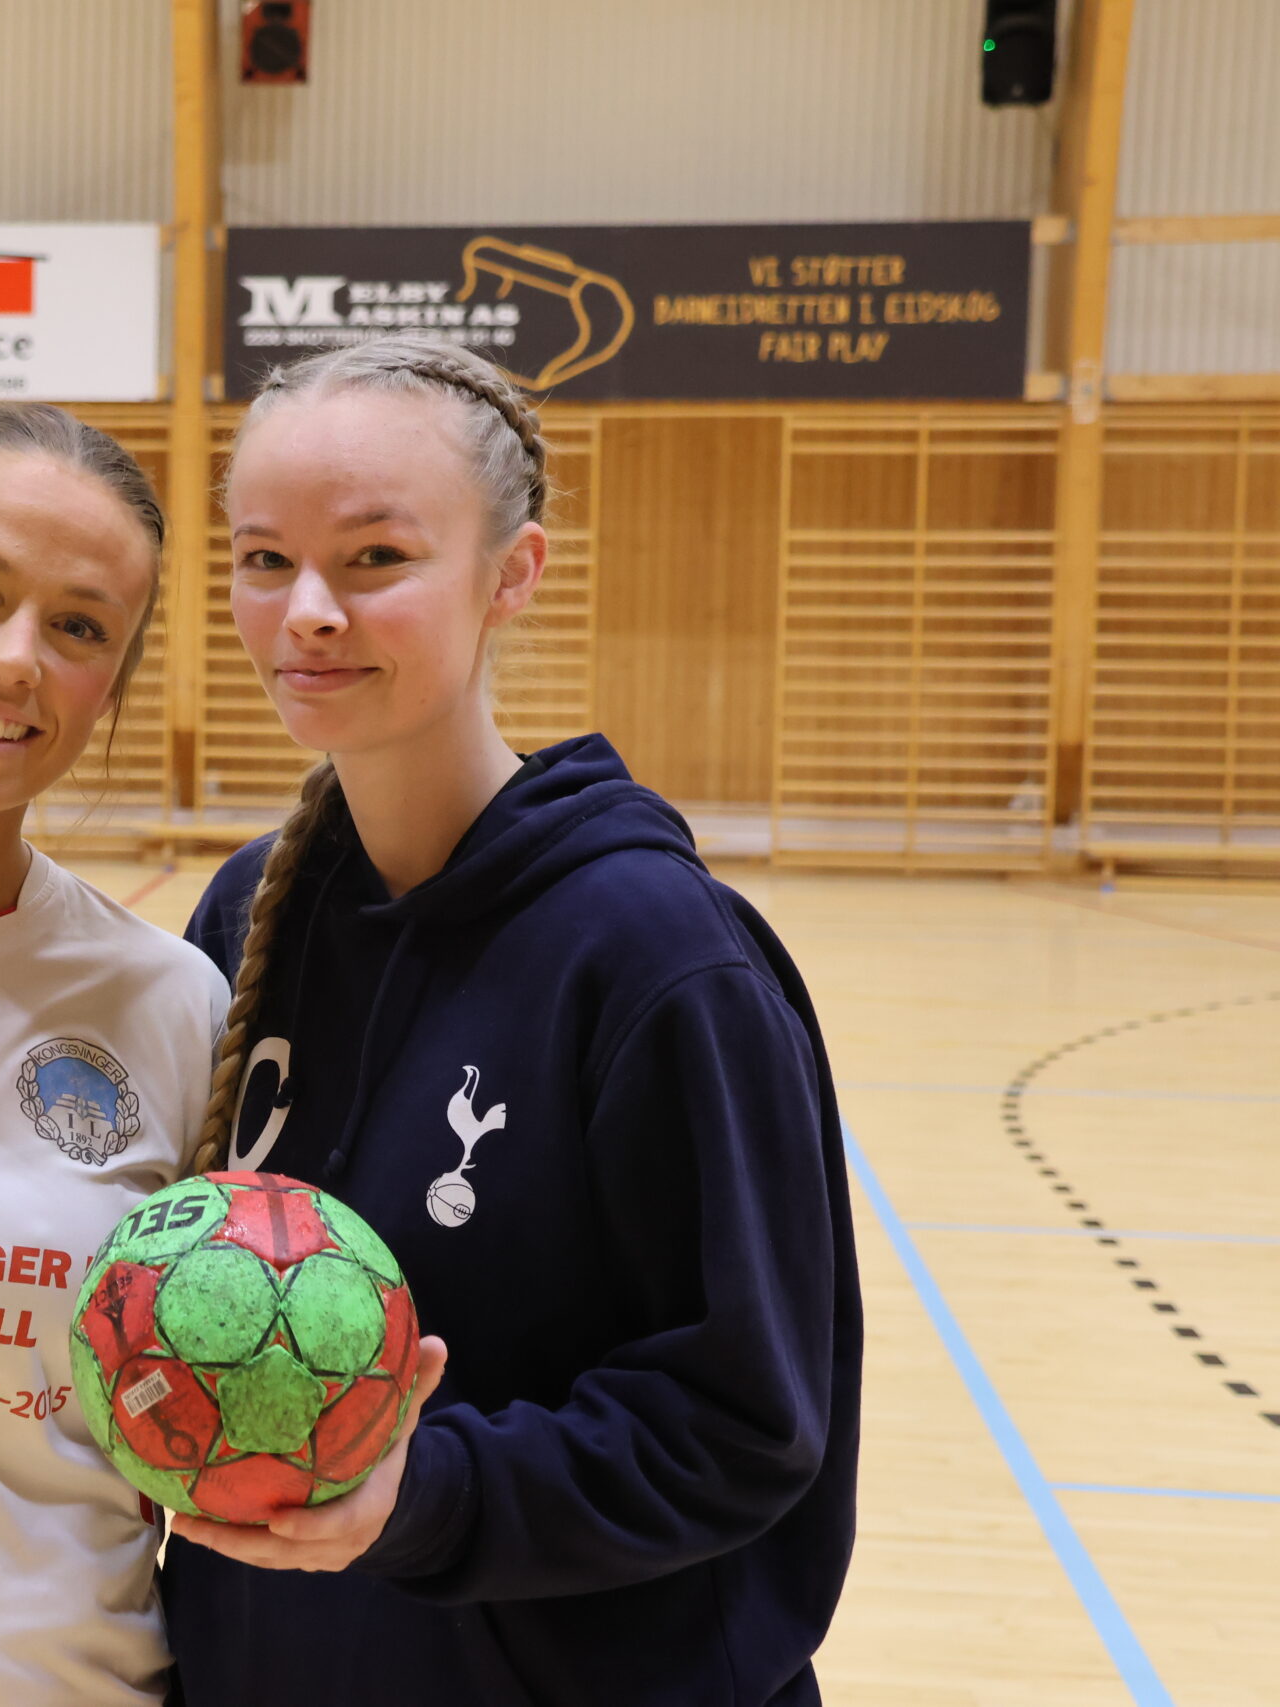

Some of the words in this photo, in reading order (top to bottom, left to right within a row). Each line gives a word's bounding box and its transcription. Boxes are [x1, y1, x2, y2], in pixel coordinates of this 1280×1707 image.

[758, 330, 821, 363] FAIR
[827, 330, 890, 363] PLAY
[34, 1043, 122, 1083] KONGSVINGER
[70, 1131, 93, 1147] 1892
